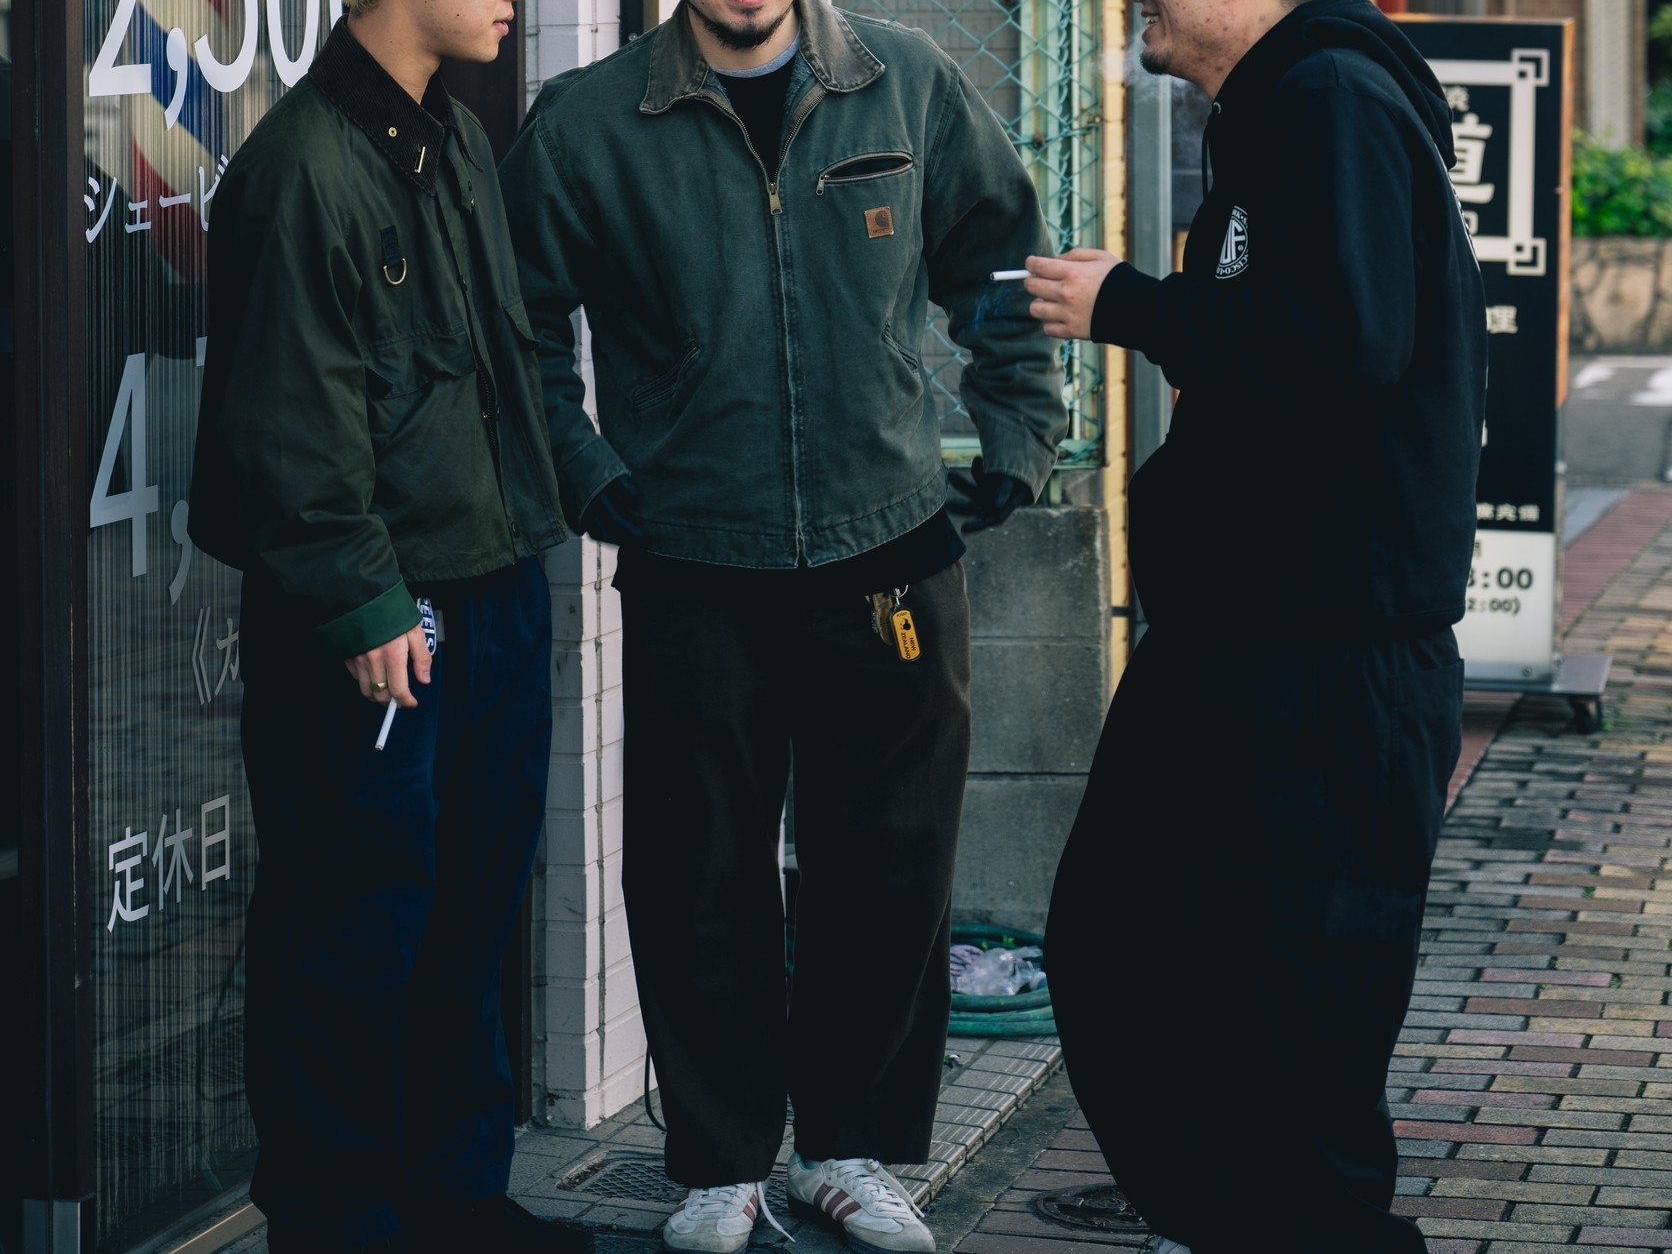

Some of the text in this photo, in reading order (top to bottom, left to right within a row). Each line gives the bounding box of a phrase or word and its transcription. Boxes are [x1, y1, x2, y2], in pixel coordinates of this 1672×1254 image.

[84, 154, 229, 244] シェービ
[90, 336, 207, 605] 4,
[900, 631, 912, 660] ZEALAND
[909, 636, 917, 652] NEW
[107, 793, 231, 934] 定休日
